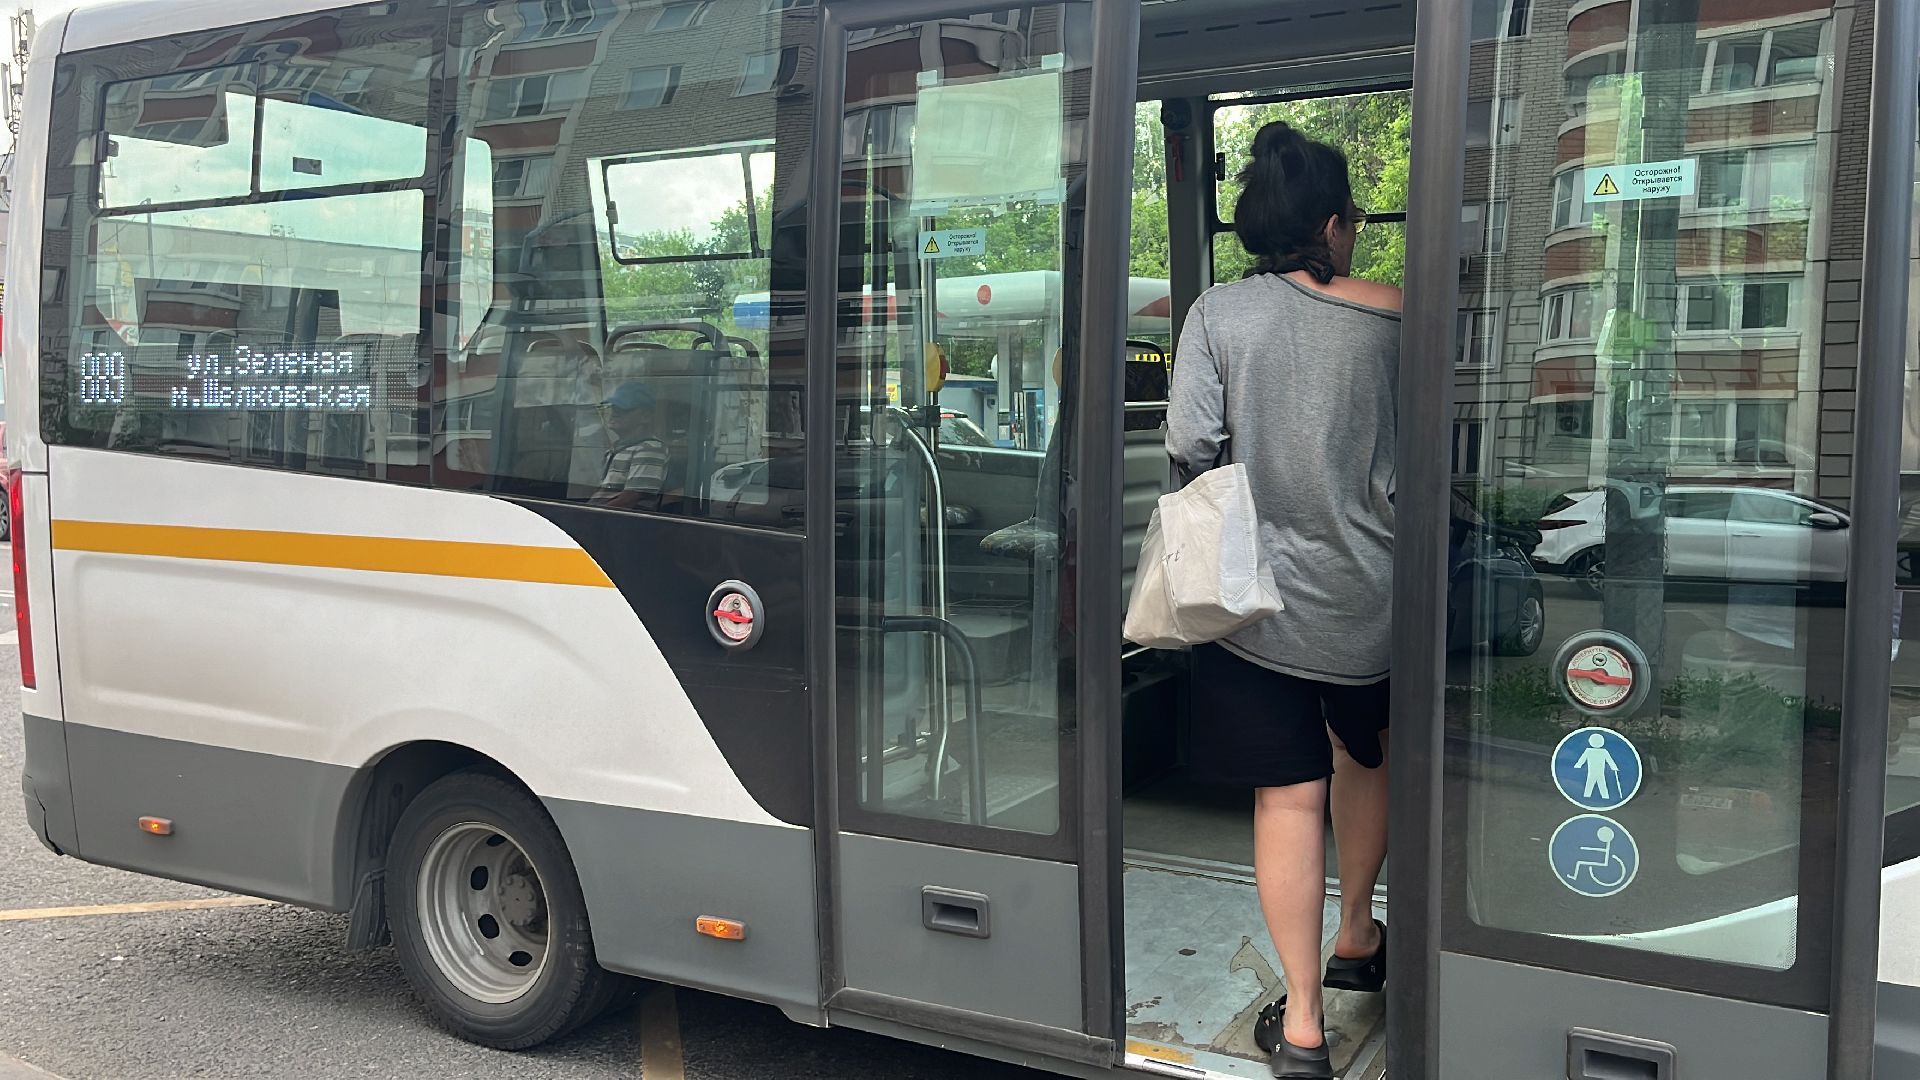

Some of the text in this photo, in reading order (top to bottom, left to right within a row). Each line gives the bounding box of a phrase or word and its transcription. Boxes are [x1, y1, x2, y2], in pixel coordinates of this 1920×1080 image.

[1634, 166, 1681, 176] Осторожно!
[1632, 176, 1683, 186] Открывается
[1643, 186, 1671, 194] наружу
[187, 345, 353, 379] ул.Зеленая
[81, 352, 125, 403] 889
